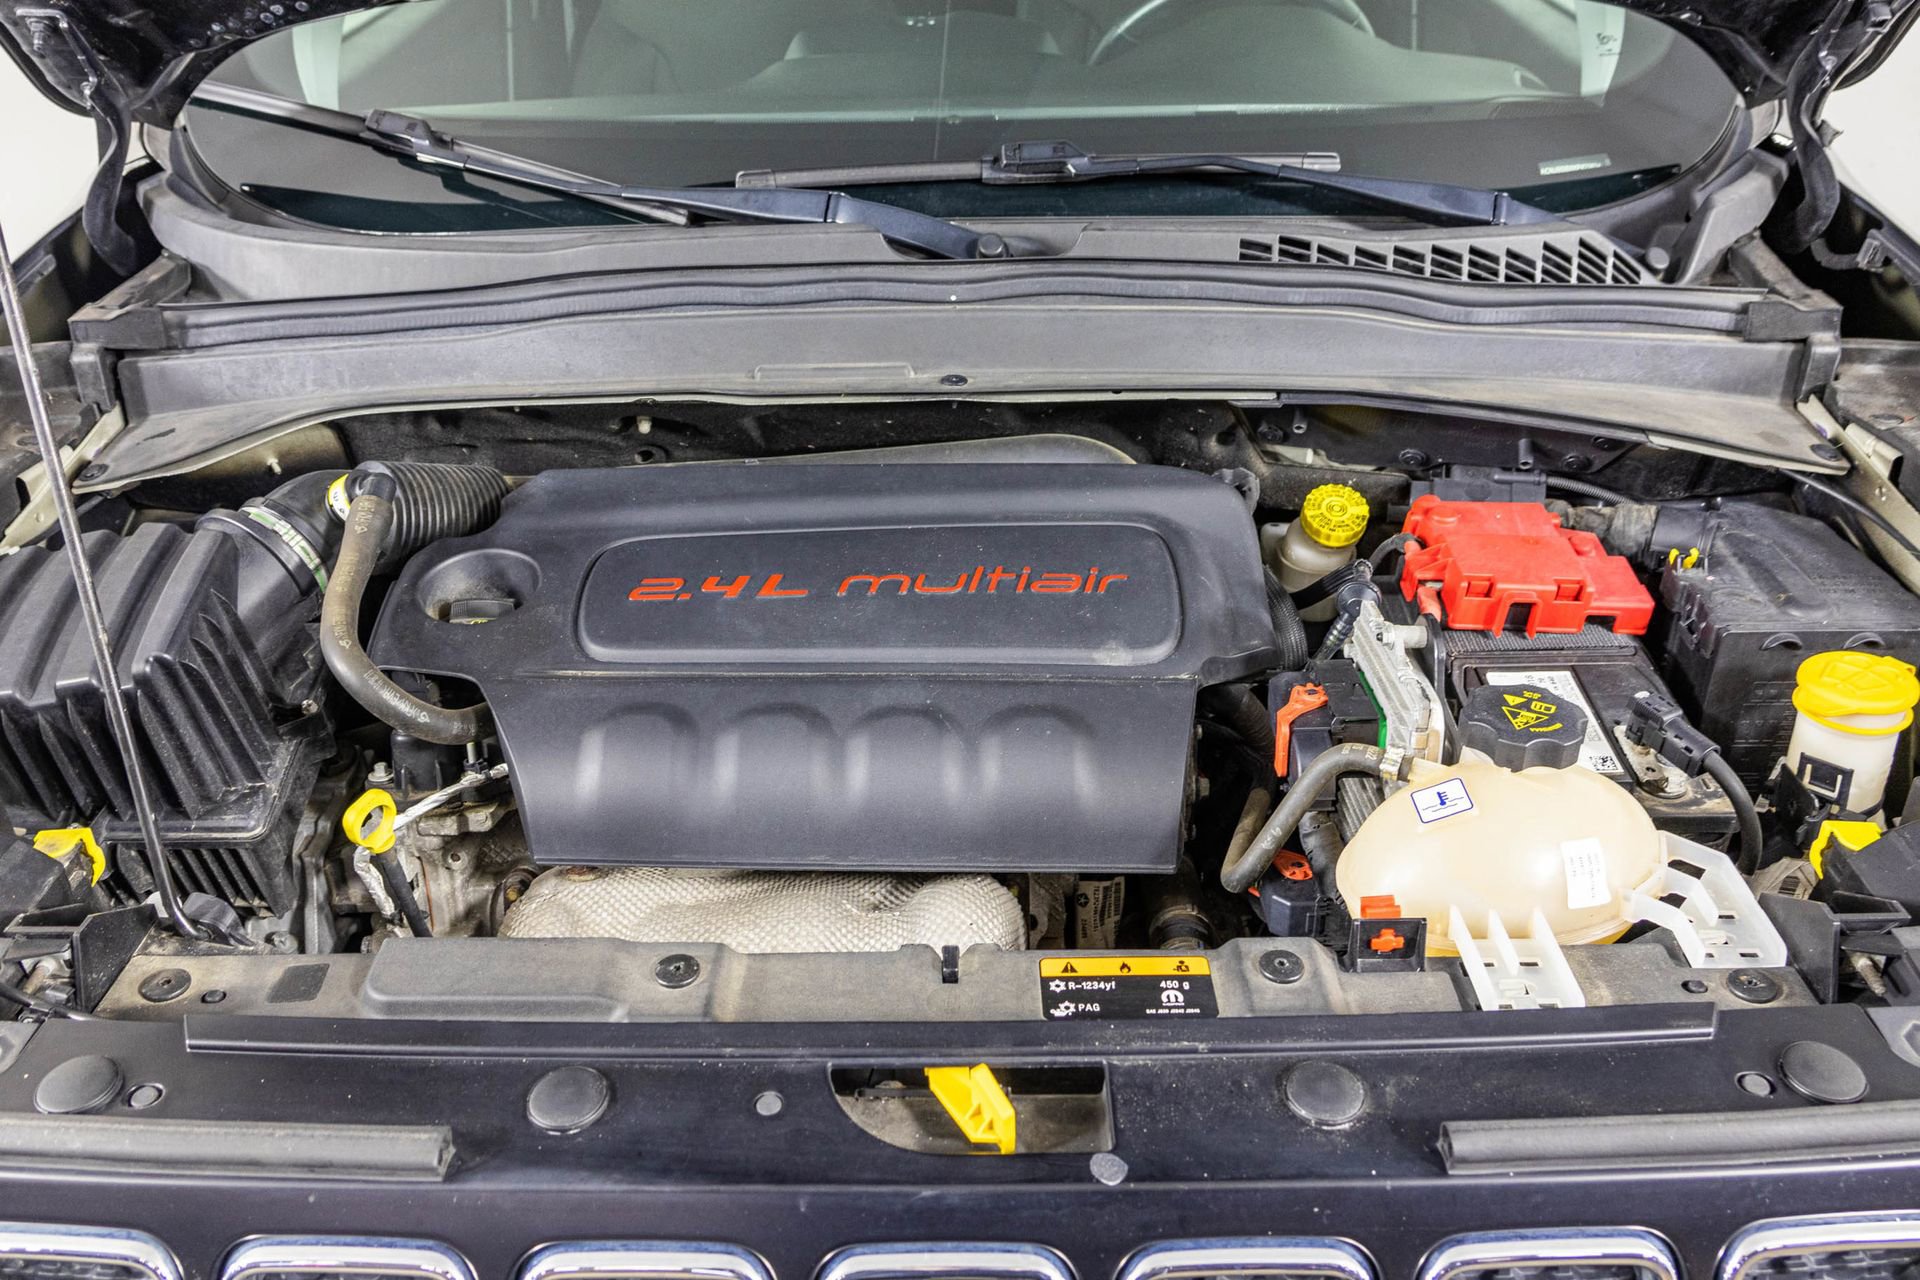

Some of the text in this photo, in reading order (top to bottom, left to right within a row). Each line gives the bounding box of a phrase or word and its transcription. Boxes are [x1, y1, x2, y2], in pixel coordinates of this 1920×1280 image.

[627, 565, 1129, 600] 2.4L multiair
[1068, 981, 1116, 991] R-1234yf
[1159, 980, 1190, 990] 450 g
[1078, 1003, 1100, 1012] PAG
